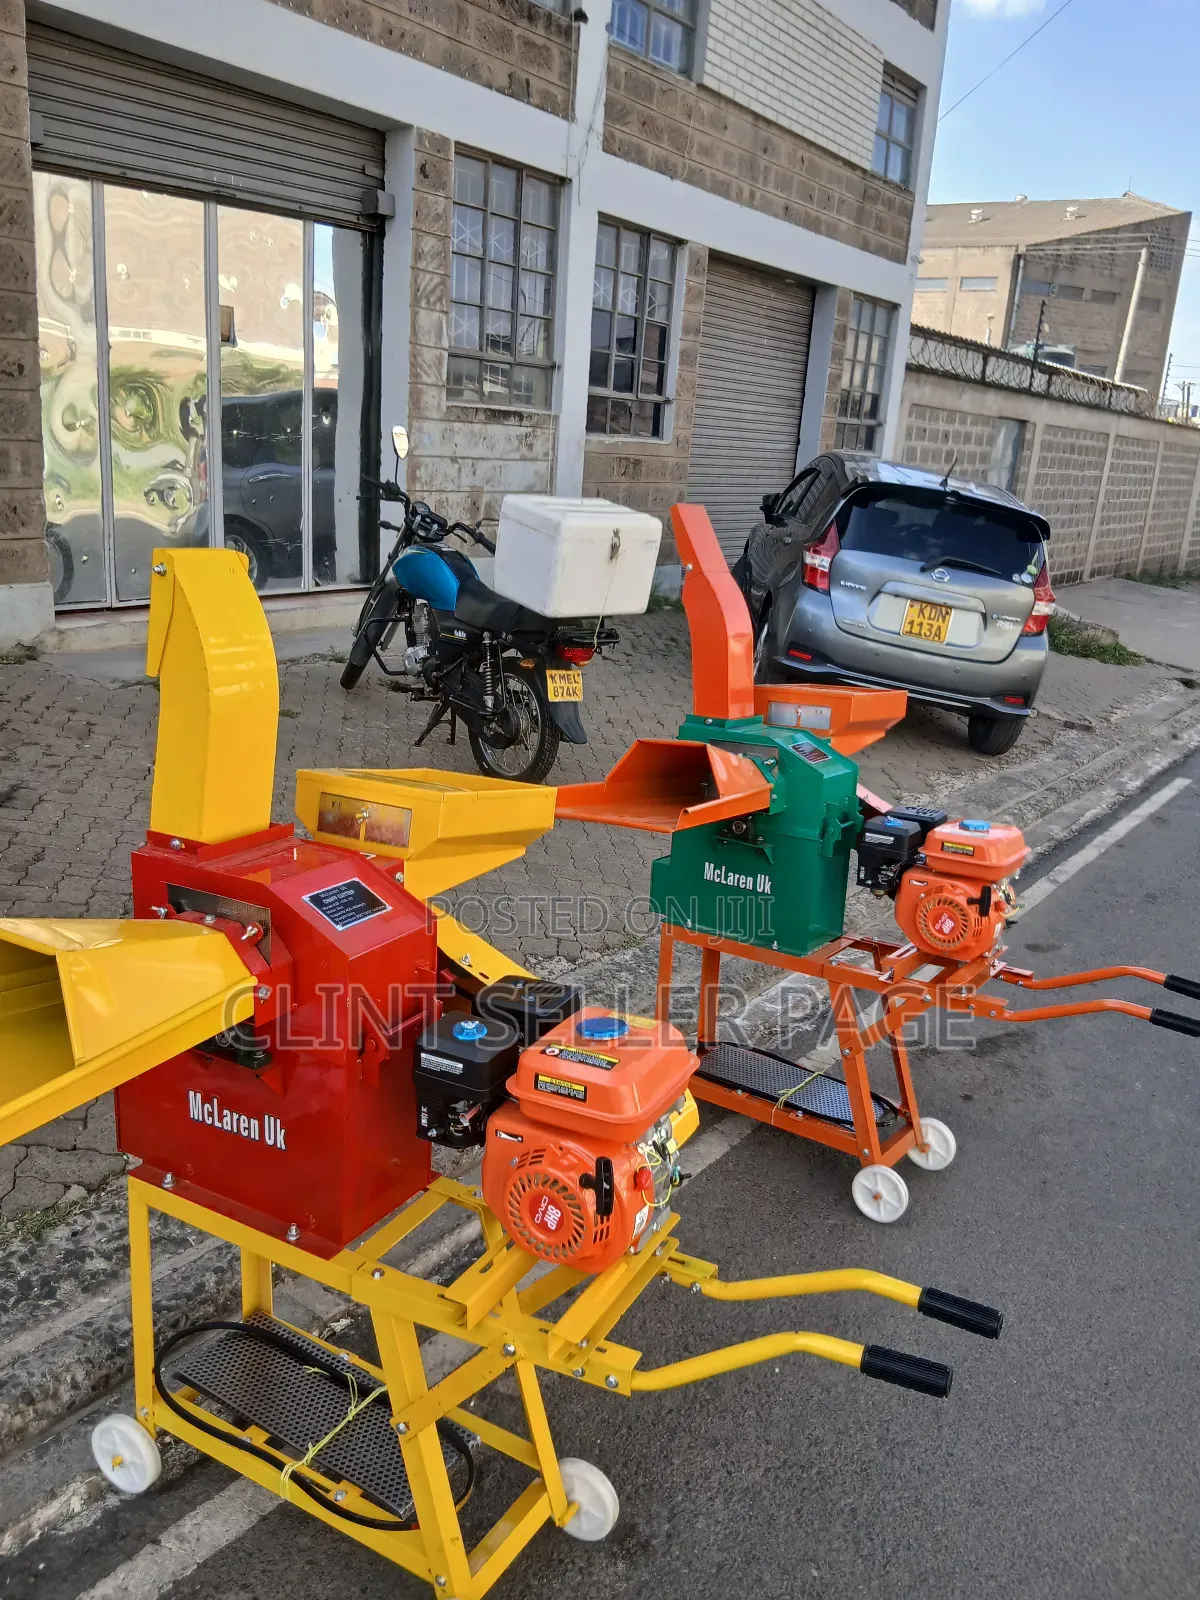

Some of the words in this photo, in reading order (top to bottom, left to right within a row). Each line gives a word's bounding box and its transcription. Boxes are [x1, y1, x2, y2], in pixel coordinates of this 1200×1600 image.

[918, 602, 948, 624] KDN
[904, 619, 942, 641] 113A
[550, 672, 581, 685] KMEL
[552, 685, 581, 699] 874K
[703, 861, 754, 891] McLaren
[756, 873, 772, 895] Uk
[188, 1089, 260, 1141] McLaren
[264, 1113, 287, 1151] Uk
[544, 1204, 562, 1230] 8HP
